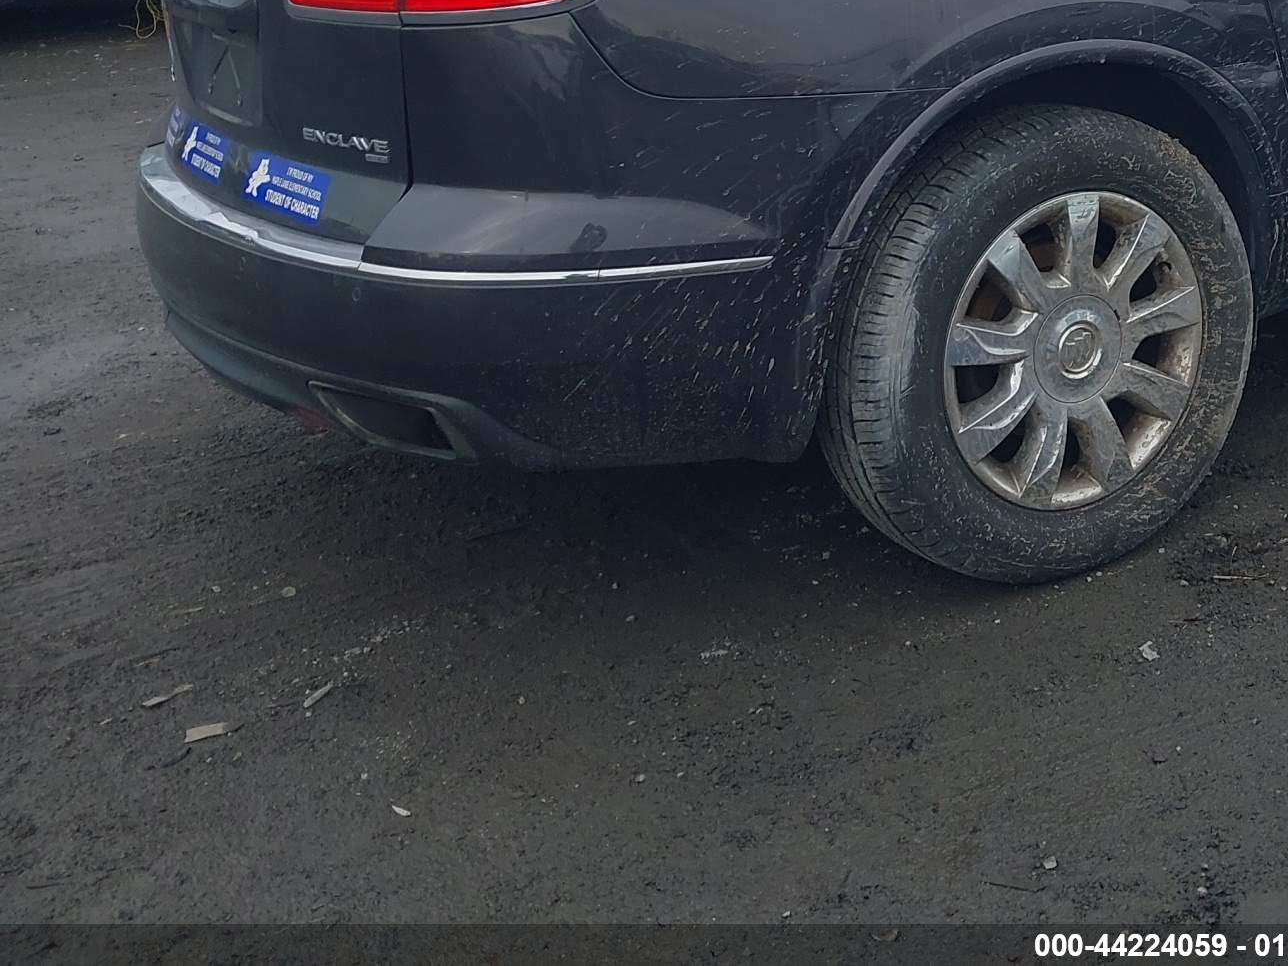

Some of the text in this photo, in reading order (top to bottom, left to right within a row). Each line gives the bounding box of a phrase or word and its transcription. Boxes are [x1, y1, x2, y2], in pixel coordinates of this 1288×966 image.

[302, 127, 391, 153] ENCLAVE
[265, 189, 286, 207] STUDENT
[291, 198, 320, 220] CHARACTER
